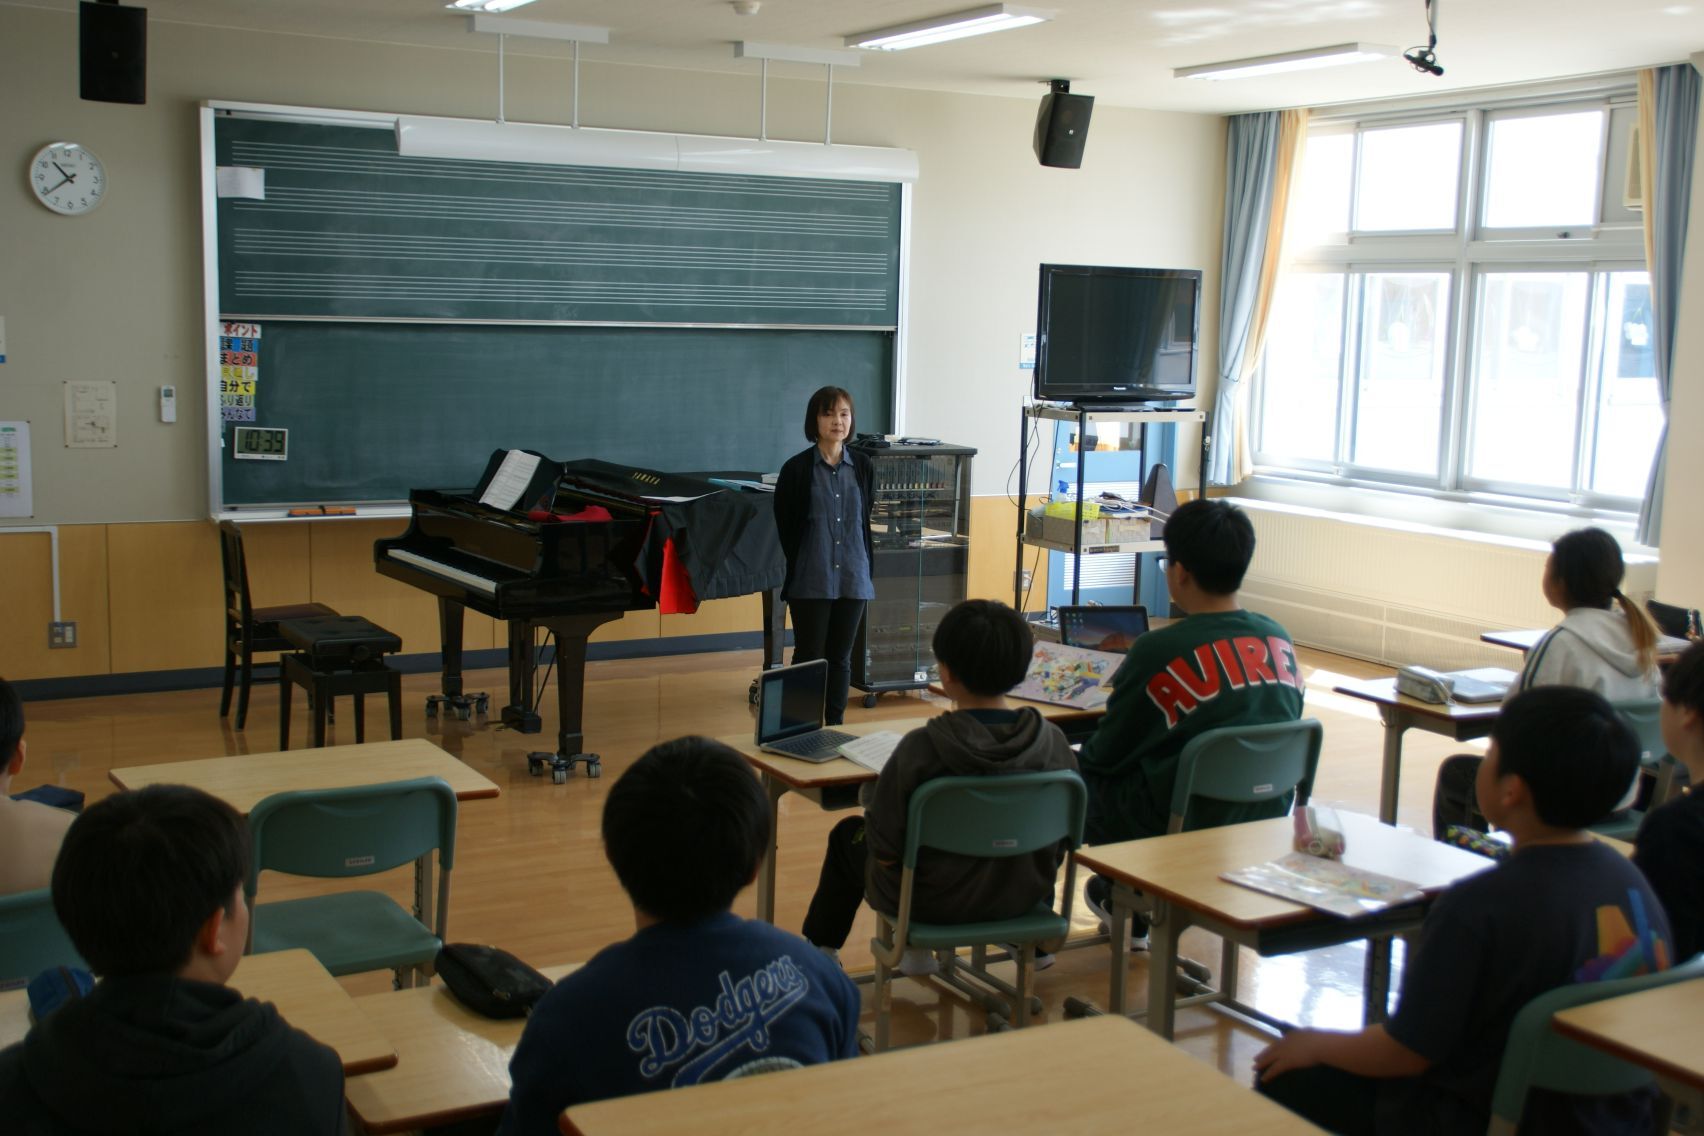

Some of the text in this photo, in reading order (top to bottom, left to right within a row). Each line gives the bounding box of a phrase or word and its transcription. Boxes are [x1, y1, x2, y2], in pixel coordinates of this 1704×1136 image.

[220, 351, 253, 366] まとめ
[244, 429, 284, 453] 10:39
[1146, 635, 1305, 730] AVIRE
[626, 954, 805, 1078] Dodgers
